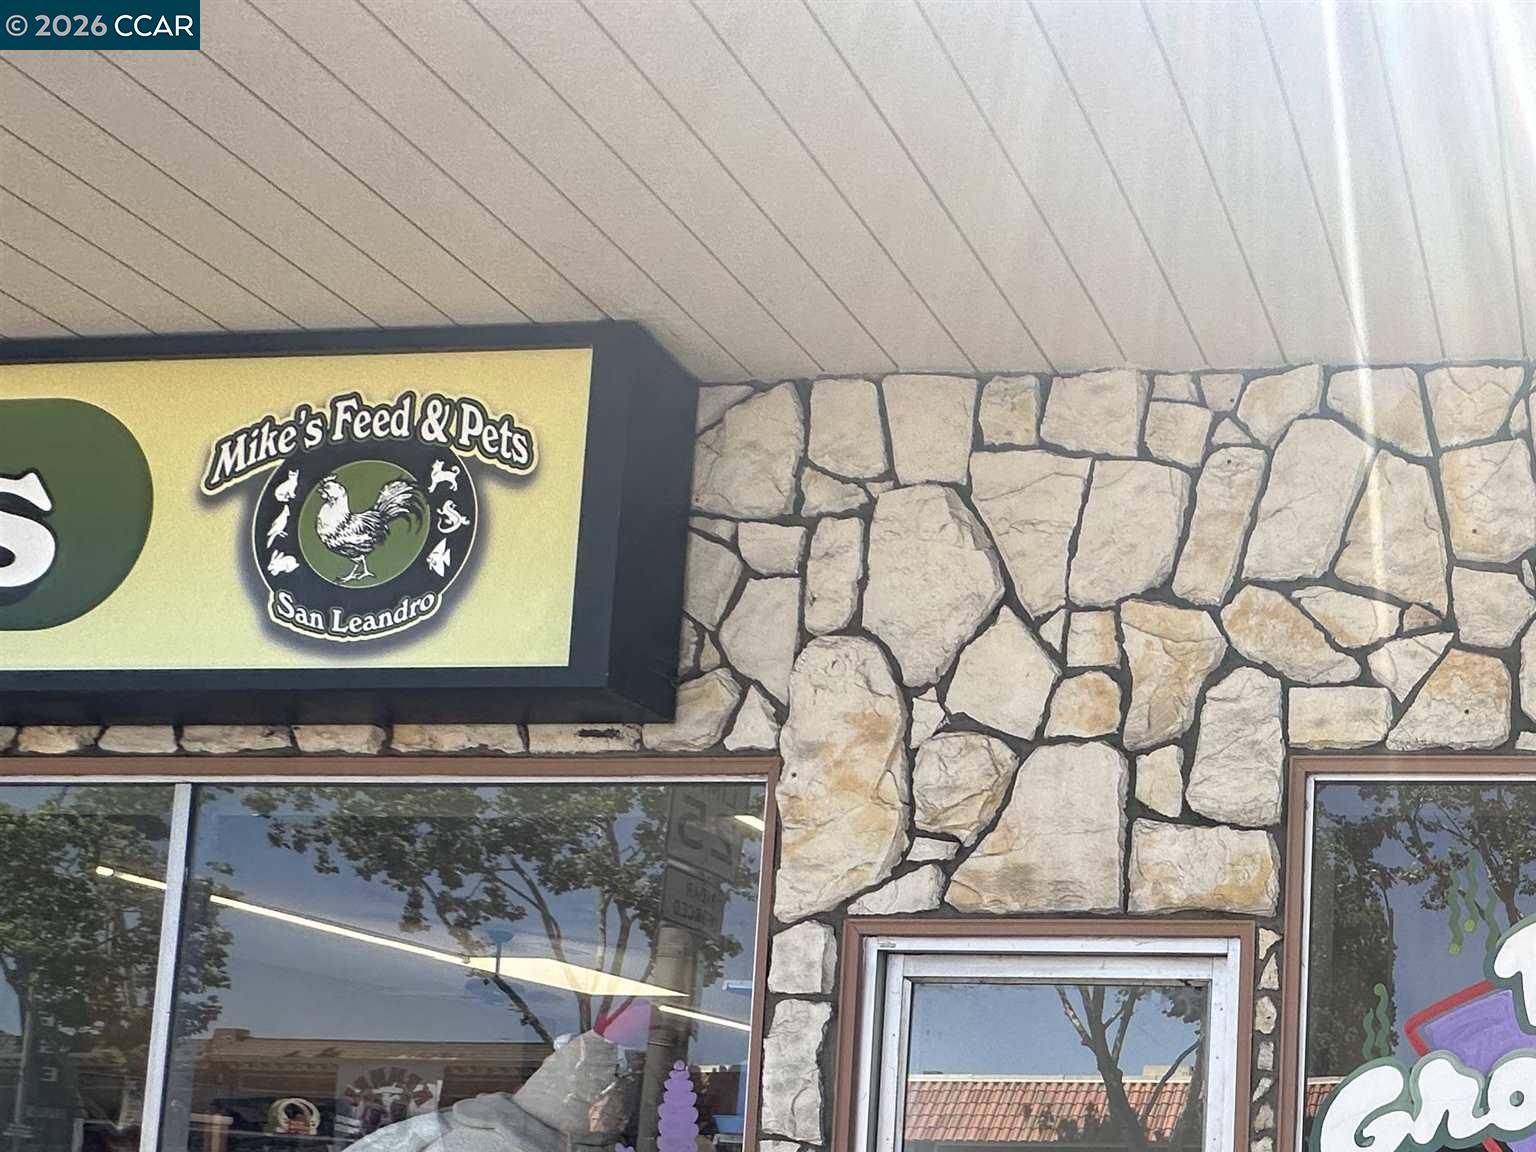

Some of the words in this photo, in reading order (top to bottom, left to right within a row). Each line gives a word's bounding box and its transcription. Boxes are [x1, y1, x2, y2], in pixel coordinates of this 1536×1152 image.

[210, 410, 324, 485] Mike's
[331, 396, 411, 441] Feed
[421, 399, 448, 443] &
[458, 402, 529, 465] Pets
[276, 590, 324, 631] San
[331, 592, 435, 634] Leandro
